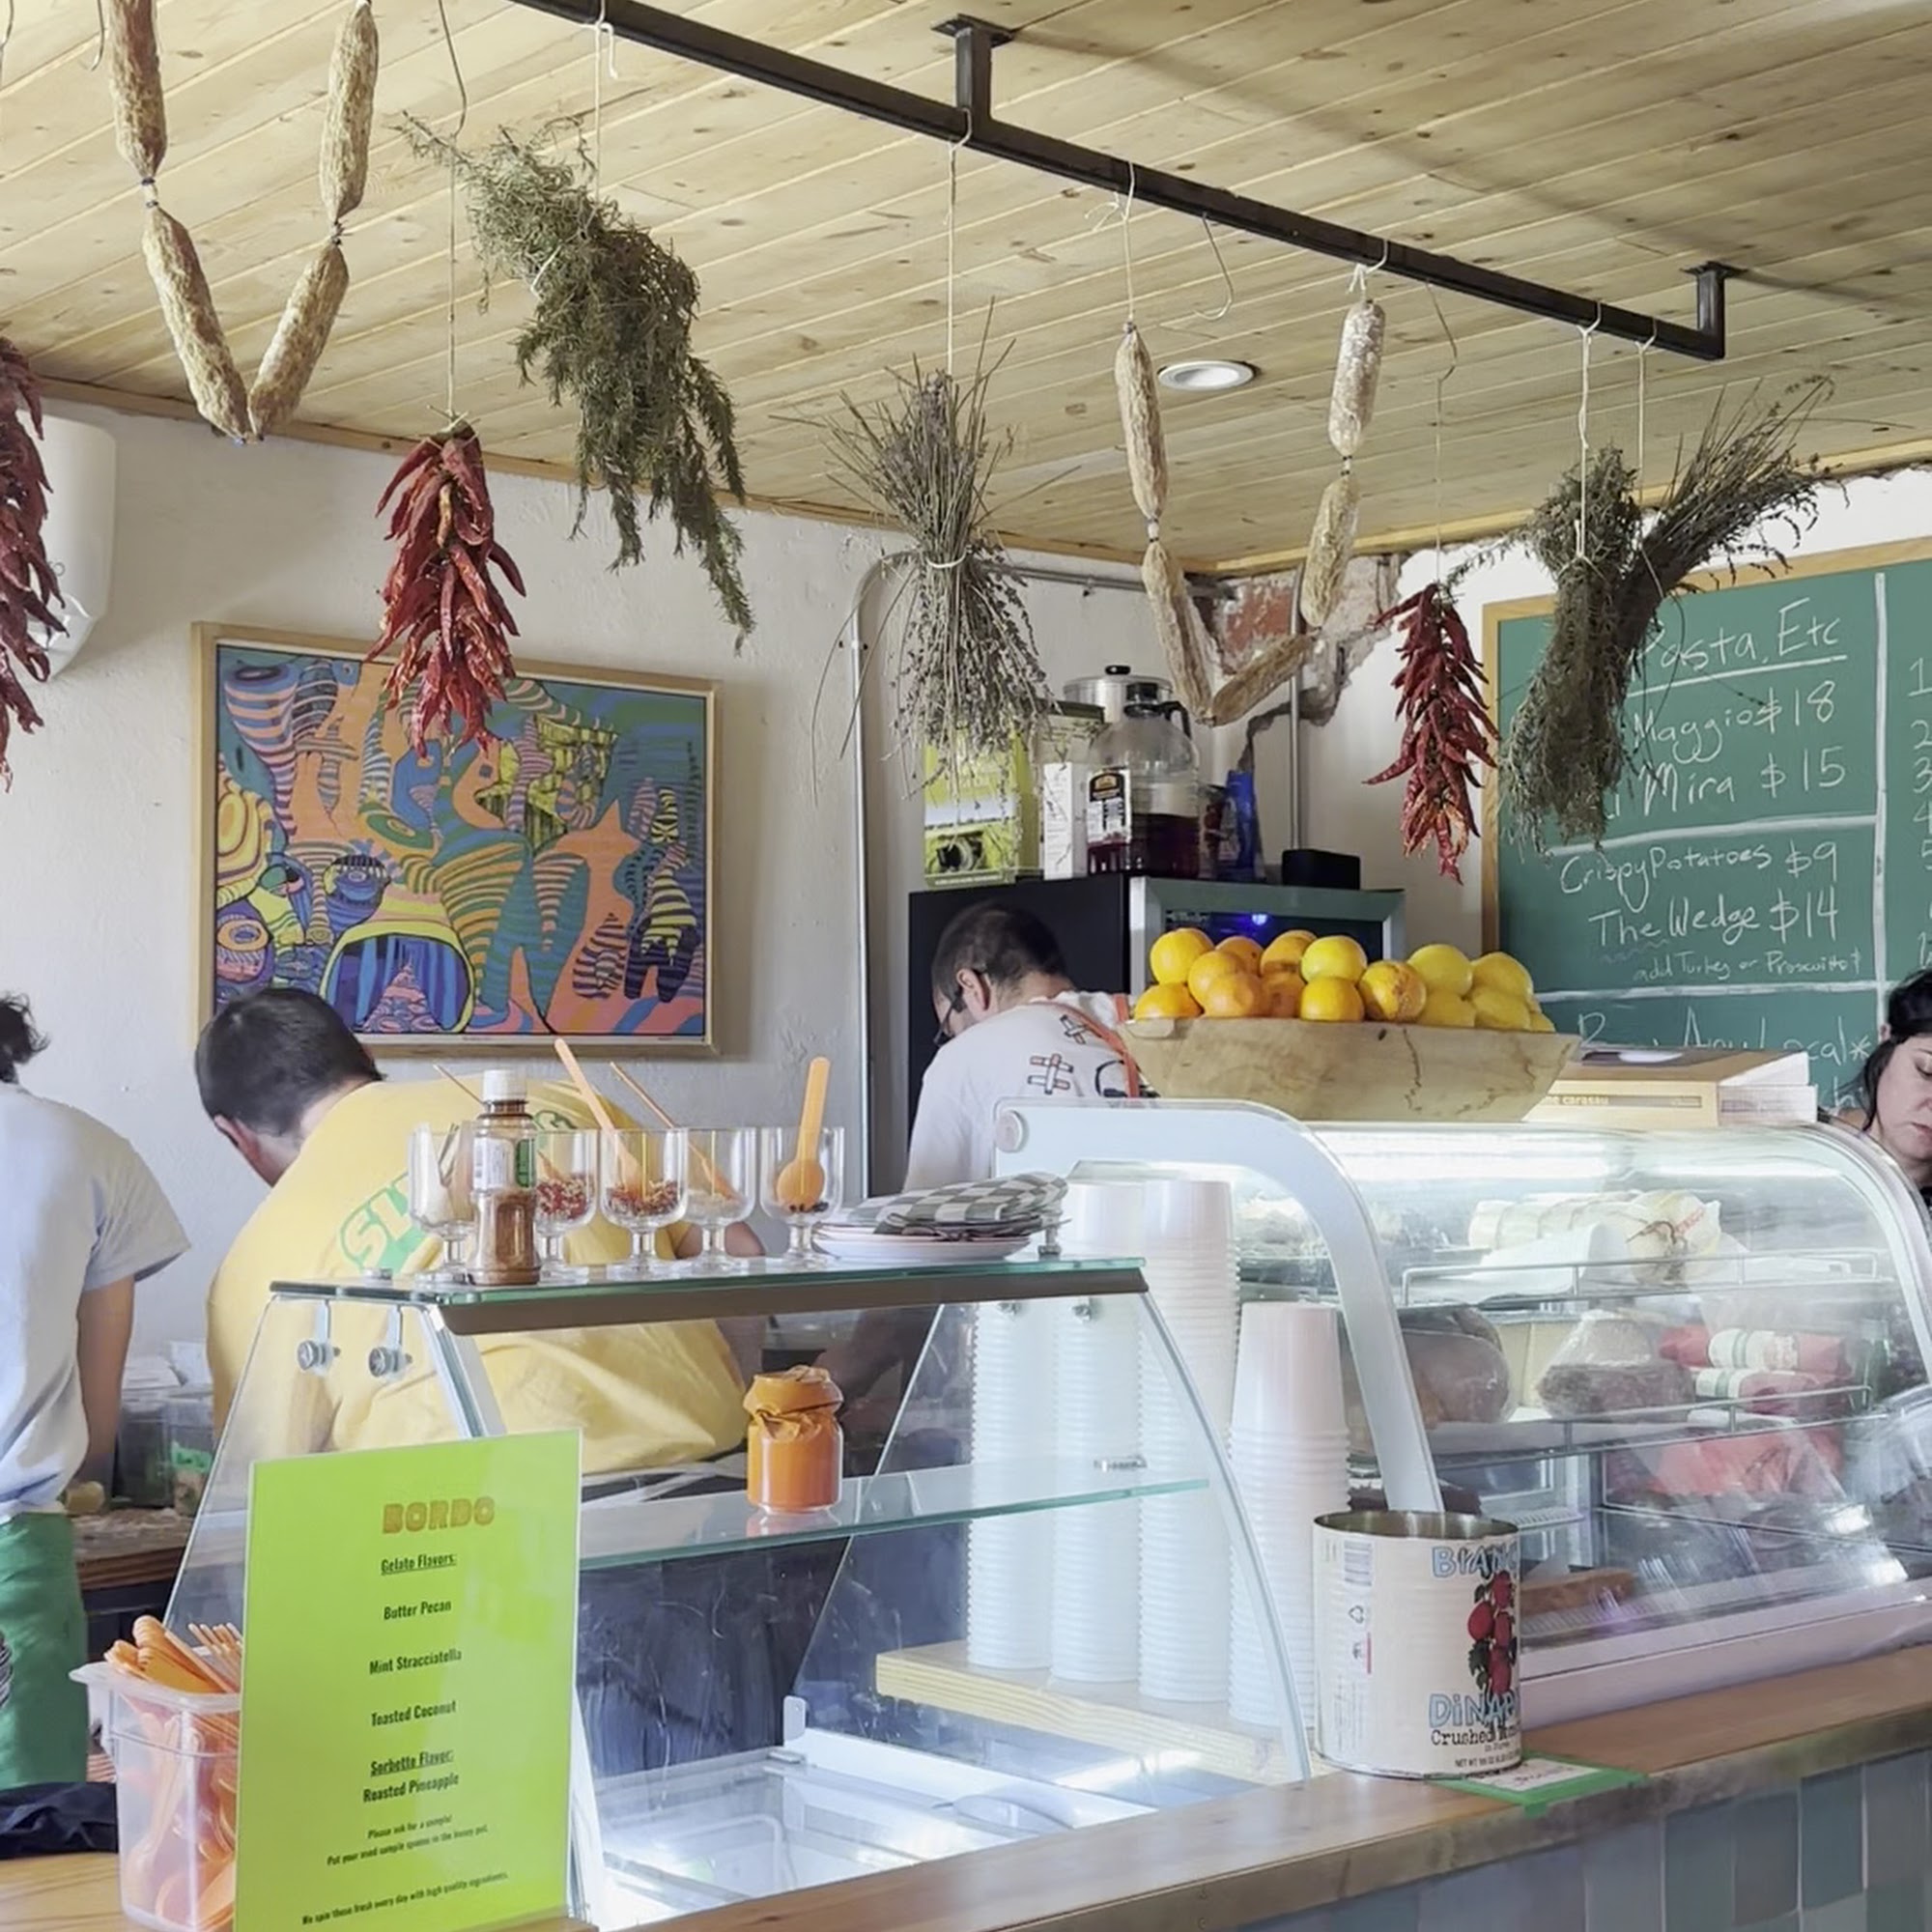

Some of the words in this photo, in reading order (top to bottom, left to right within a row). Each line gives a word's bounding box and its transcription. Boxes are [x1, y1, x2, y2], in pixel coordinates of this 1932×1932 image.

[1776, 598, 1842, 657] Etc
[1634, 709, 1754, 764] Maggio
[1754, 680, 1837, 734] $18
[1638, 761, 1736, 816] Mira
[1760, 746, 1847, 799] $15
[1785, 840, 1837, 881] $9
[1588, 909, 1662, 946] The
[1669, 894, 1760, 946] Wedge
[1769, 888, 1838, 944] $14
[1633, 953, 1673, 981] add
[1673, 951, 1731, 980] Turkey
[1739, 959, 1759, 971] or
[383, 1495, 496, 1534] BORDO
[381, 1557, 415, 1575] Gelato
[384, 1605, 417, 1620] Butter
[420, 1601, 452, 1615] Pecan
[370, 1659, 393, 1674] Mint
[396, 1648, 462, 1670] Stracciatella
[371, 1707, 412, 1727] Toasted
[413, 1700, 456, 1719] Coconut
[1431, 1728, 1496, 1747] Crushed
[363, 1782, 406, 1804] Roasted
[409, 1773, 459, 1794] Pineapple
[367, 1828, 391, 1839] Please
[327, 1855, 341, 1866] Put
